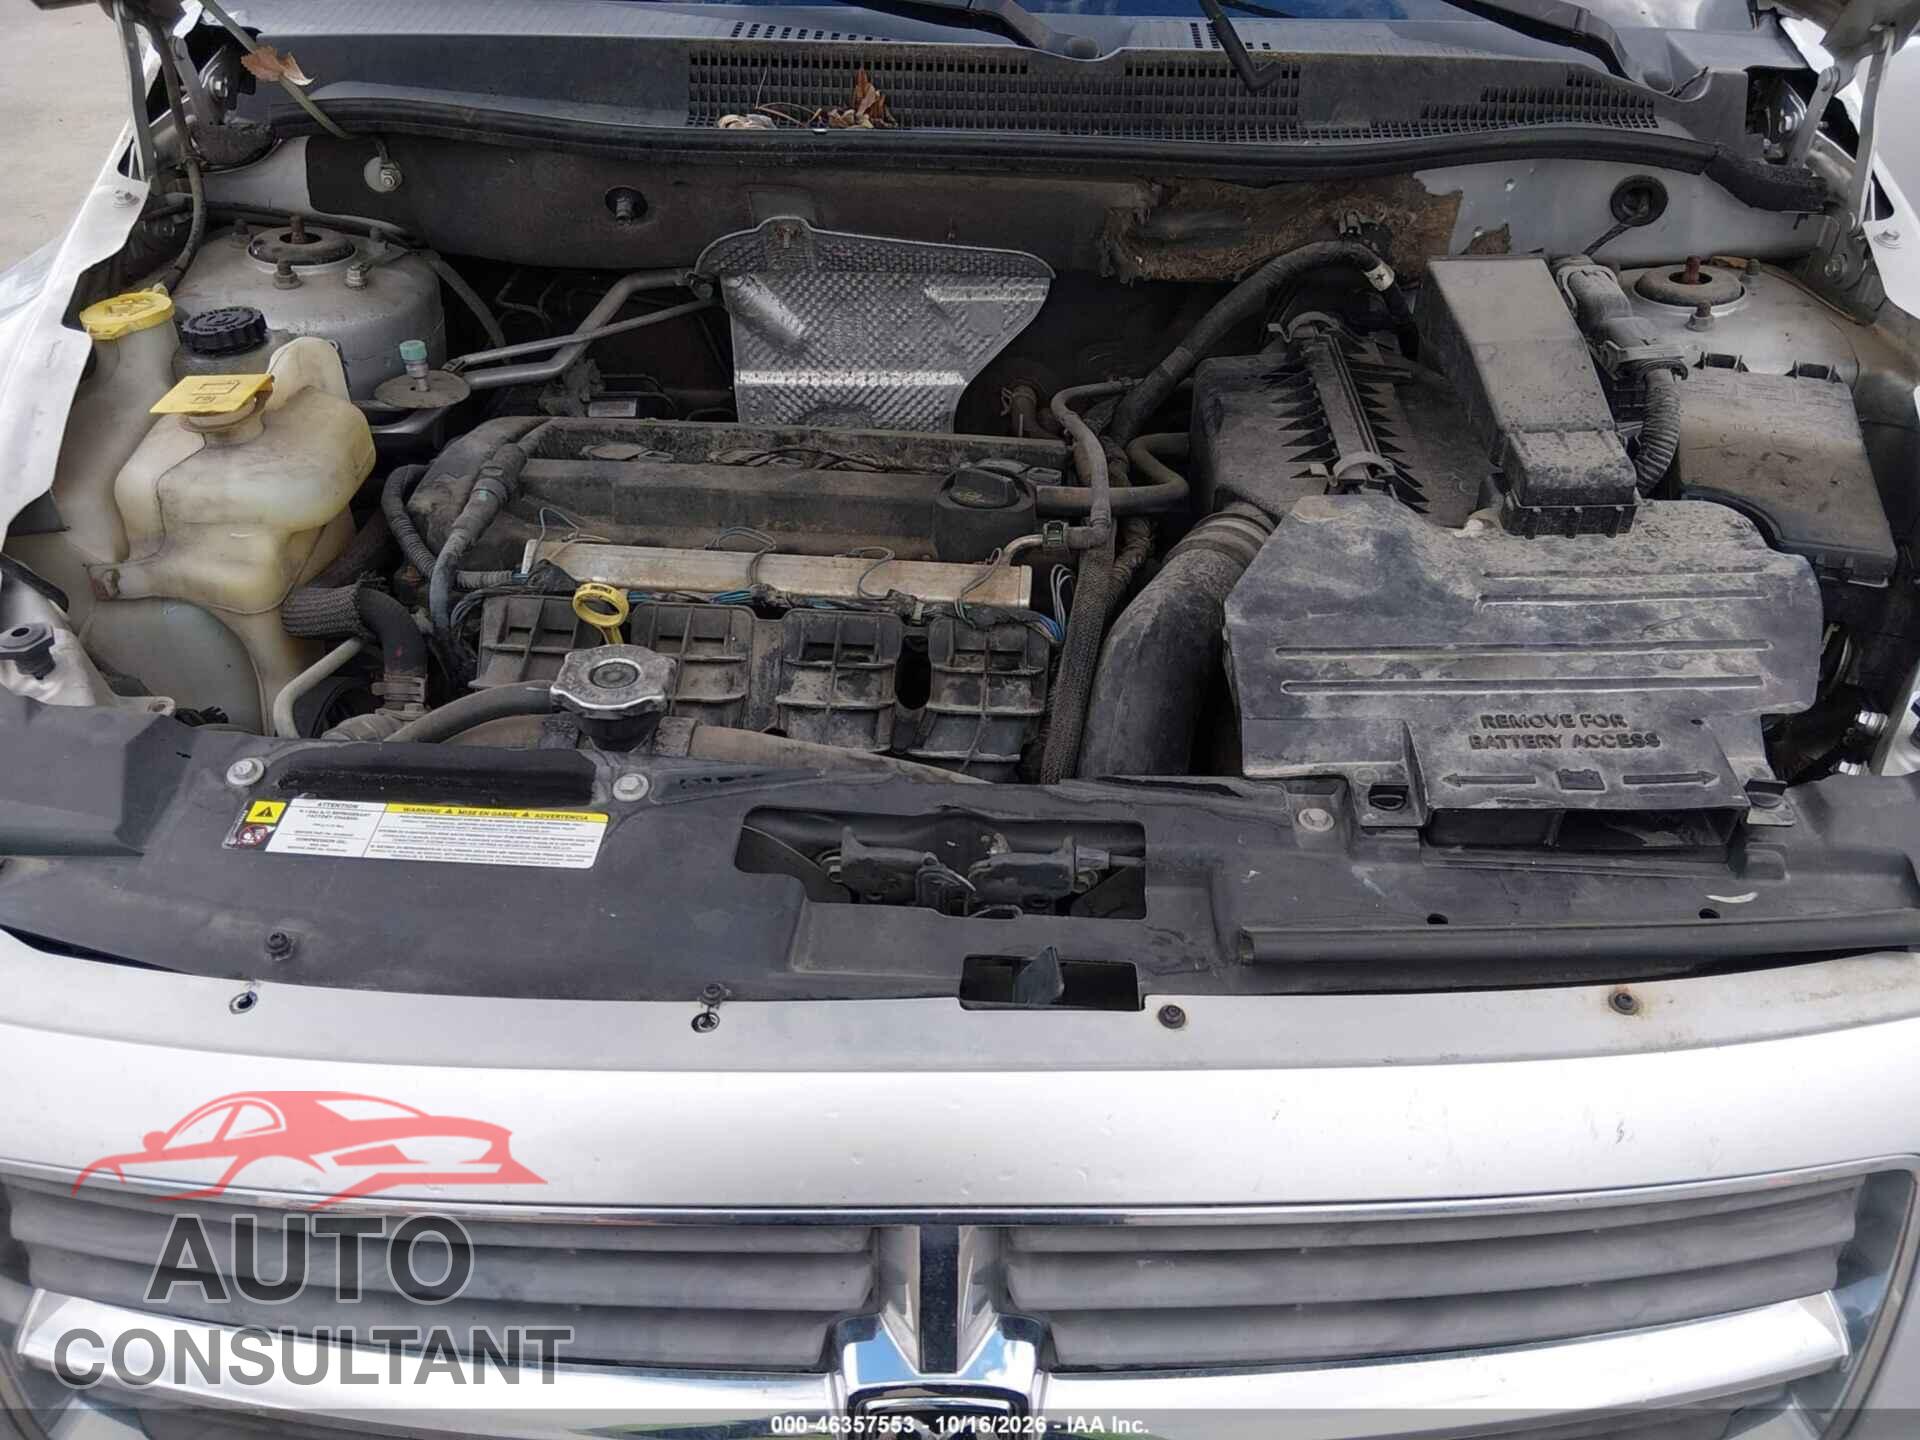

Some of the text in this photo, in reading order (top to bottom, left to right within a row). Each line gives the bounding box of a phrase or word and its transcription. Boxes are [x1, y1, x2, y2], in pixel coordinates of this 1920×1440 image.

[1480, 713, 1628, 729] REMOVE FOR
[1469, 733, 1661, 750] BATTERY ACCESS
[403, 806, 441, 814] WARNING
[535, 813, 589, 821] ADVERTENCIA
